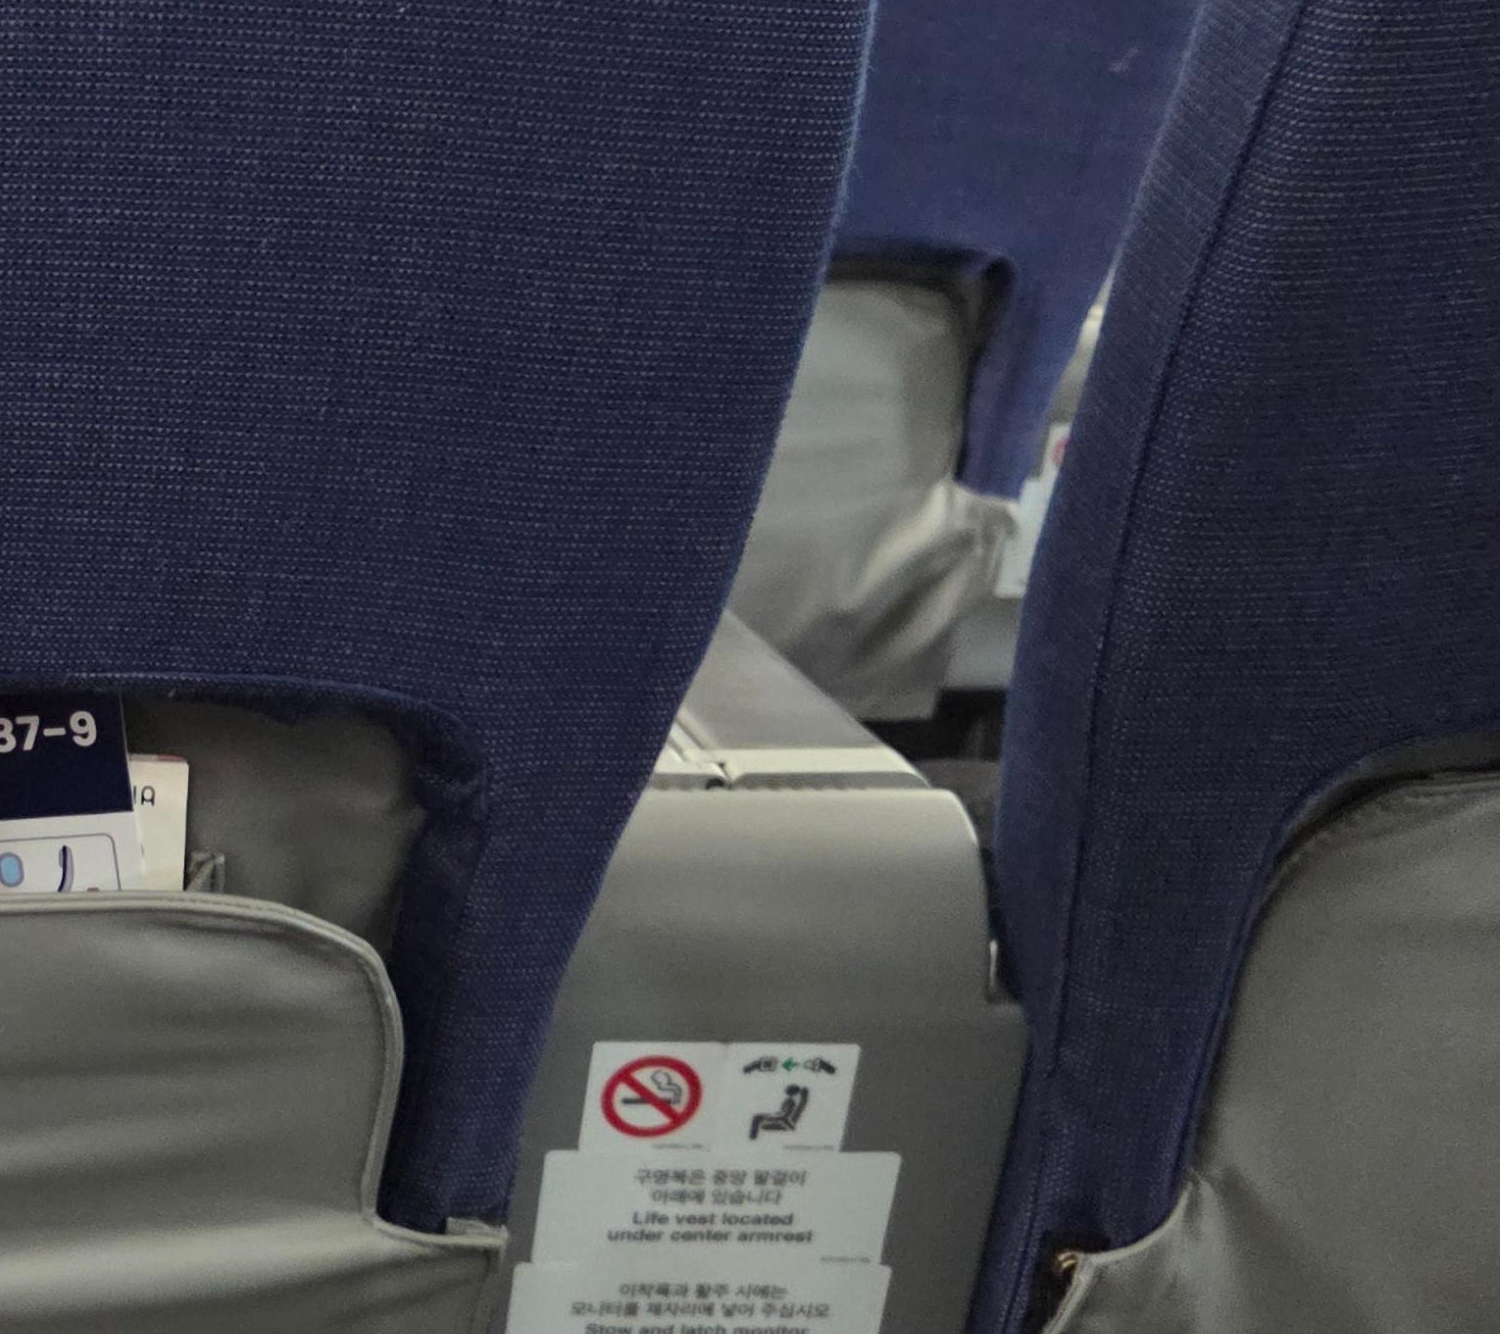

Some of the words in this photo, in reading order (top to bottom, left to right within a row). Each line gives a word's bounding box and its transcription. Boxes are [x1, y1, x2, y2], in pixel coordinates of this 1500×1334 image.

[711, 1188, 783, 1205] 있습니다
[632, 1210, 670, 1226] Life
[674, 1210, 715, 1226] vest
[721, 1212, 795, 1226] located
[607, 1228, 664, 1243] under
[669, 1228, 731, 1243] center
[736, 1228, 813, 1243] armrest
[760, 1301, 831, 1318] 주십시오
